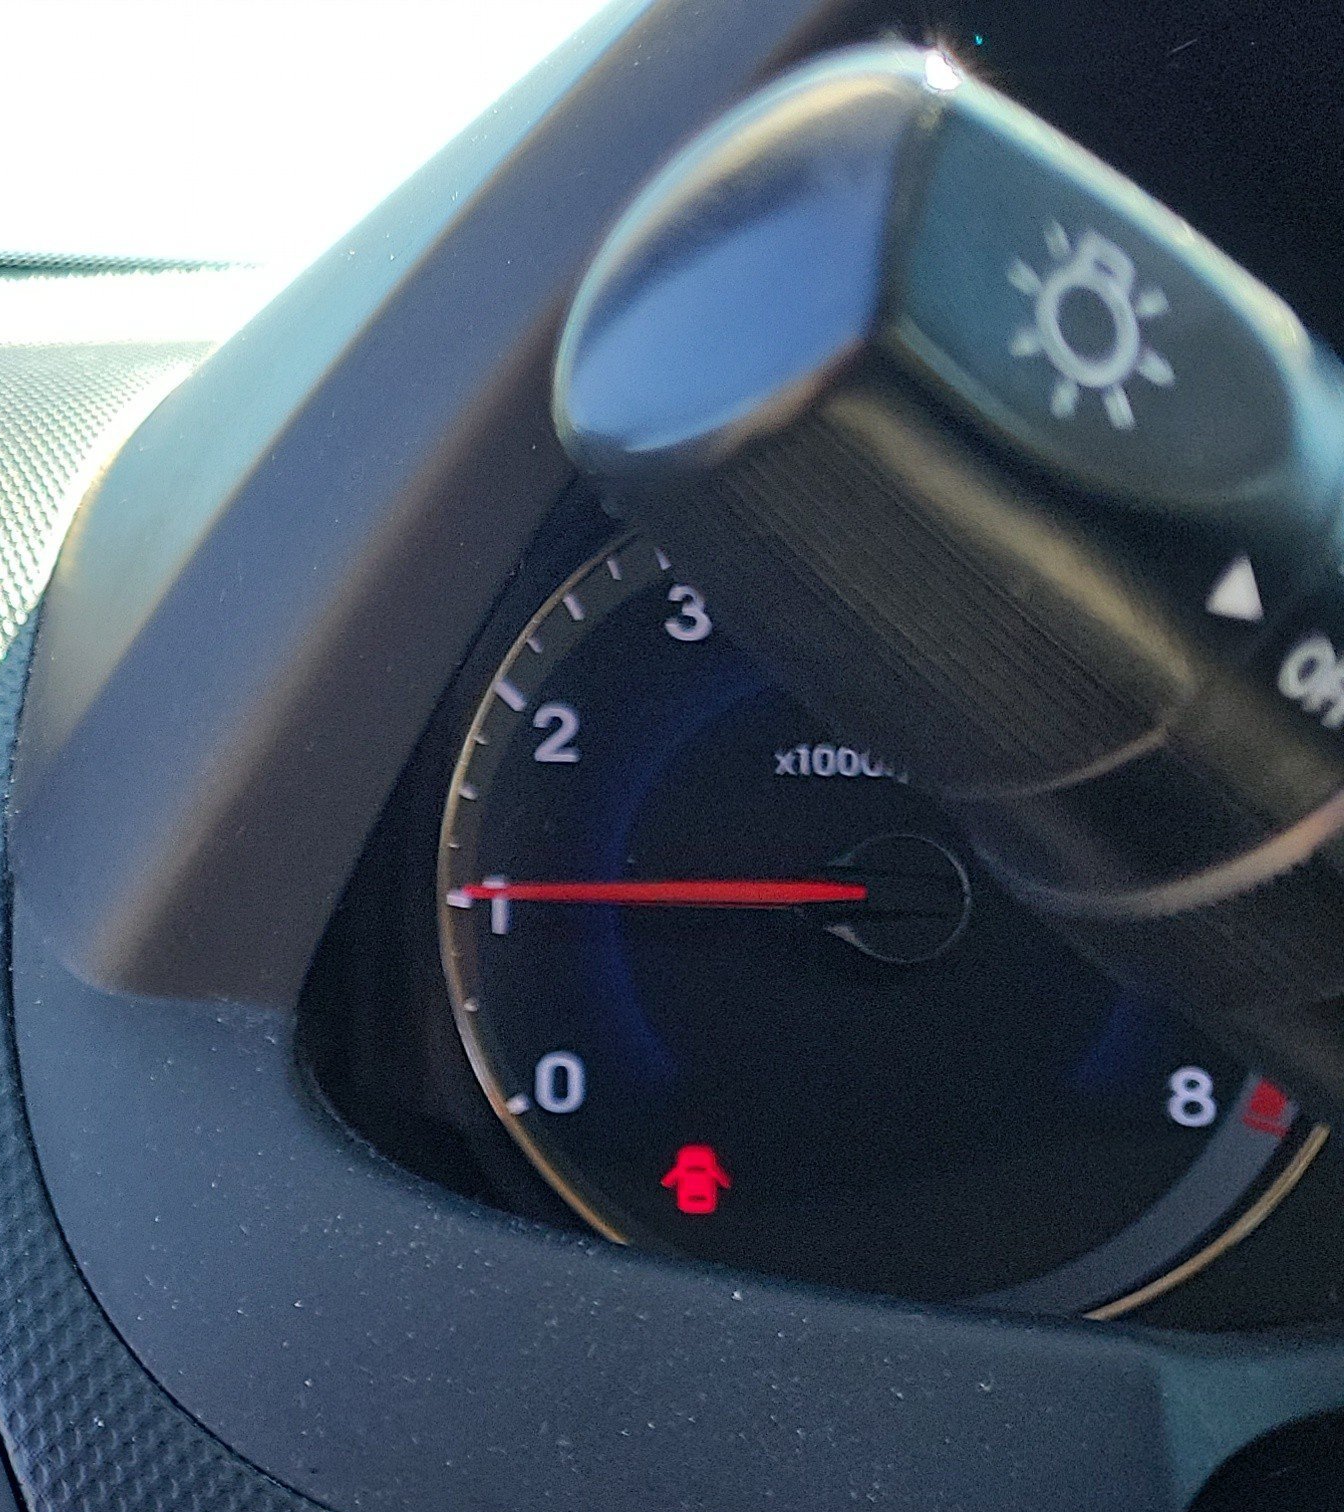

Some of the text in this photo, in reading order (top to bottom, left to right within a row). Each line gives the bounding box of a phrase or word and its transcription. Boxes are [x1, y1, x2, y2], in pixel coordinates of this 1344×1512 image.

[664, 584, 713, 642] 3
[533, 702, 581, 762] 2
[534, 1051, 587, 1114] 0
[1168, 1065, 1217, 1127] 8
